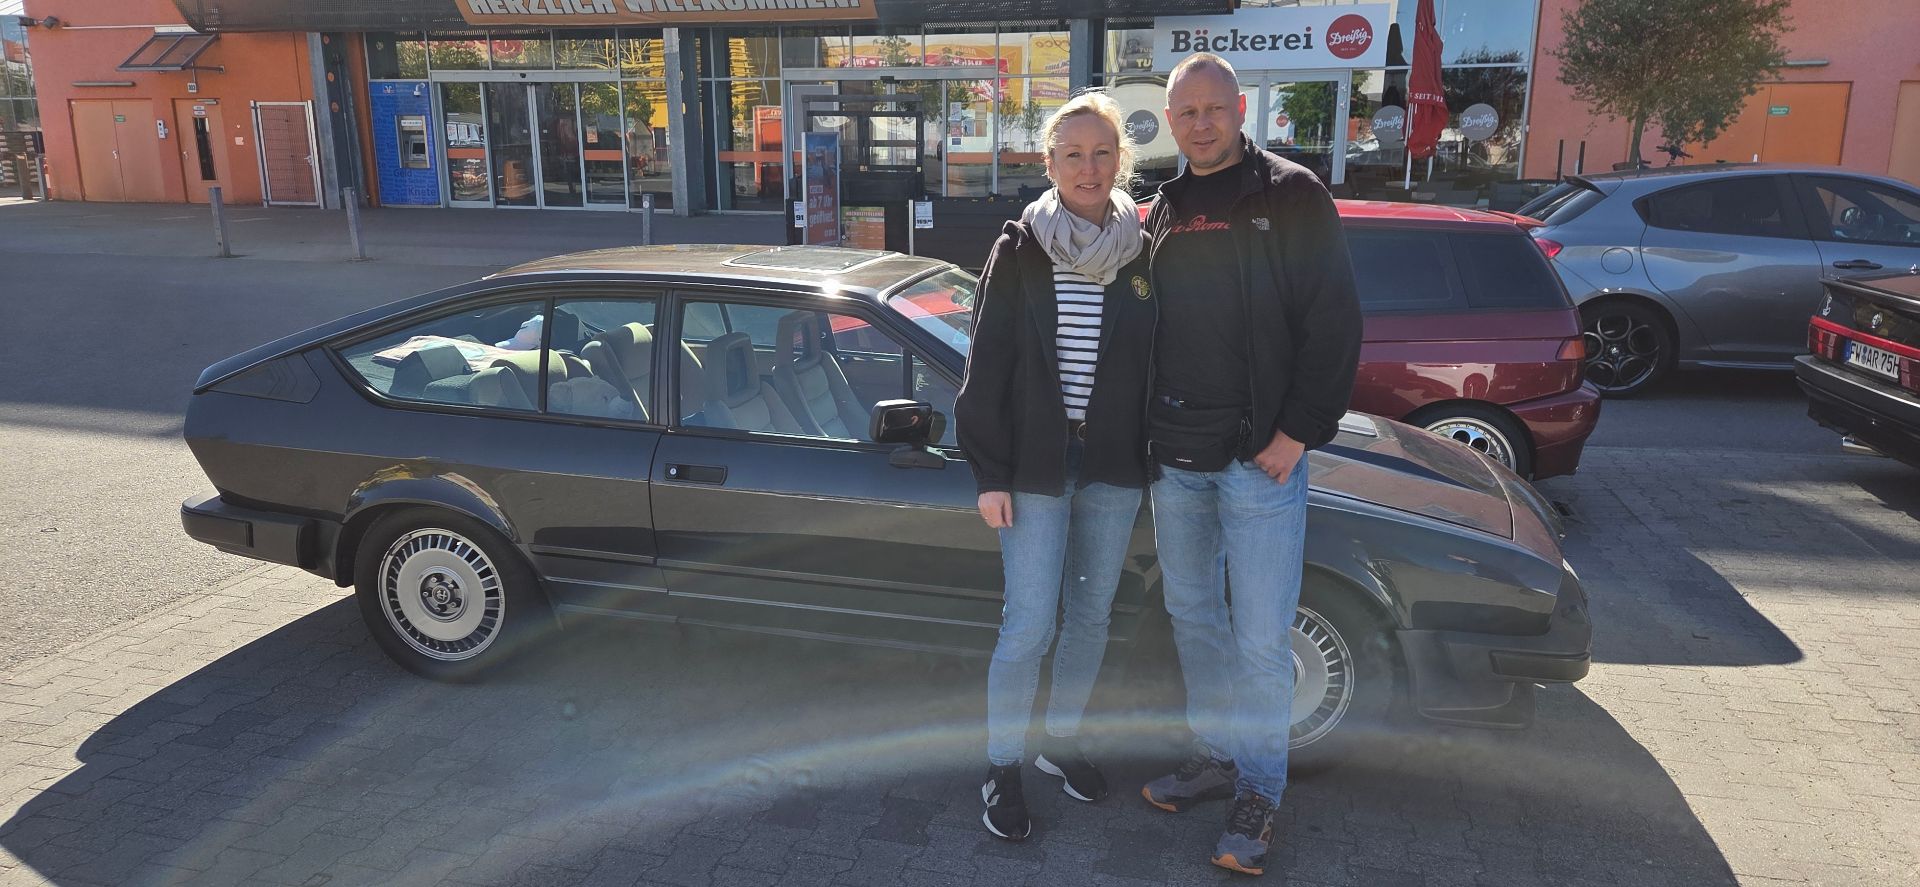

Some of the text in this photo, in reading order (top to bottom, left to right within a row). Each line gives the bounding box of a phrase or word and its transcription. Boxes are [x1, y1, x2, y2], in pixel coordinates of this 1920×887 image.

[1170, 26, 1313, 53] Bäckerei
[1328, 27, 1371, 46] Dreißig
[1461, 113, 1498, 129] Dreißig
[1850, 342, 1862, 363] FW
[1866, 348, 1879, 369] AR
